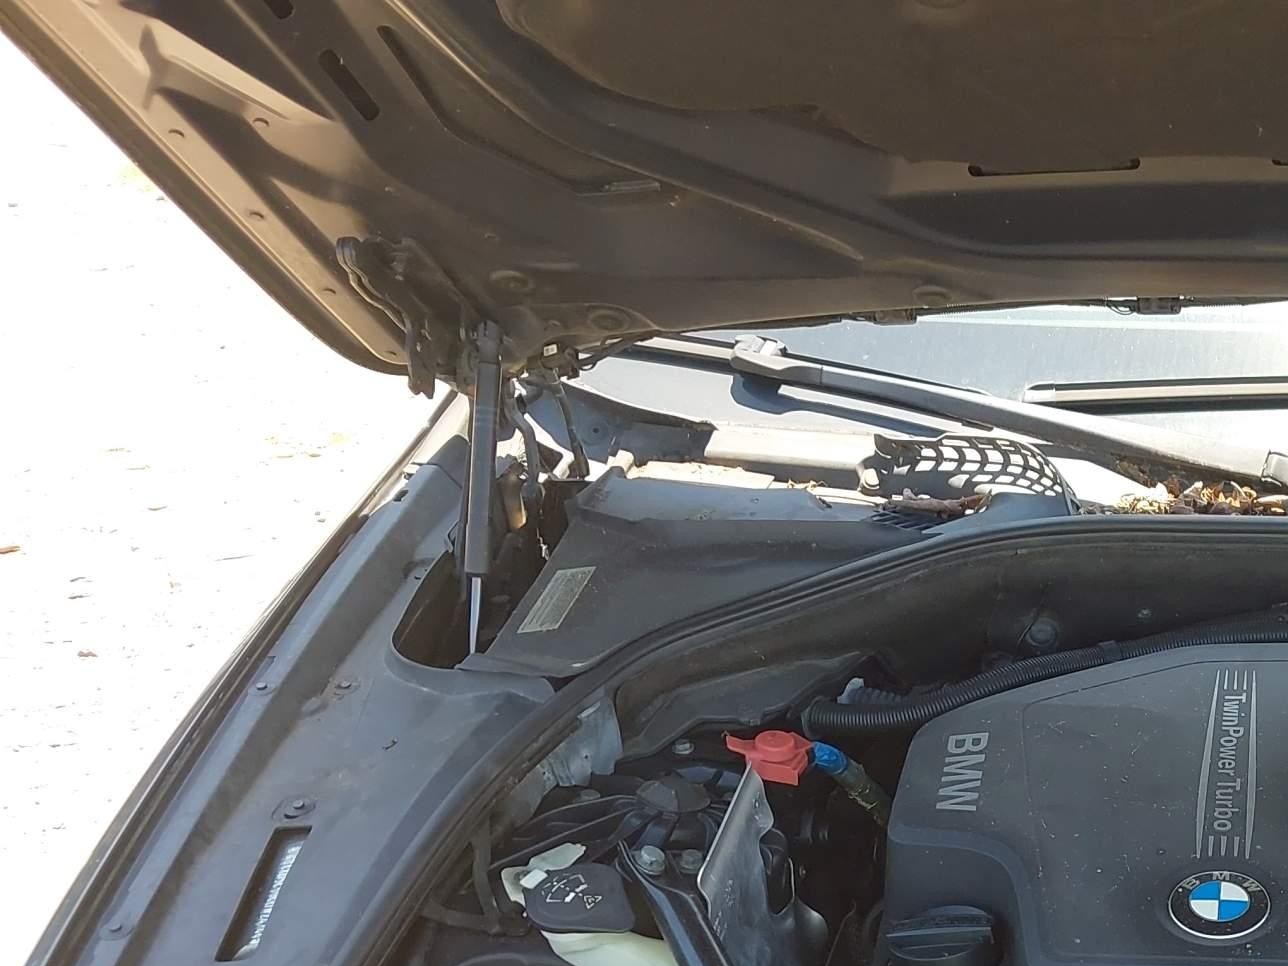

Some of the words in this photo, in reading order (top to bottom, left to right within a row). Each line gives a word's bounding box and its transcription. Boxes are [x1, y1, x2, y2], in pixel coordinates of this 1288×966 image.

[1217, 692, 1247, 776] TwinPower
[935, 732, 990, 812] BMW
[1213, 778, 1241, 832] Turbo
[1181, 871, 1261, 892] BMW
